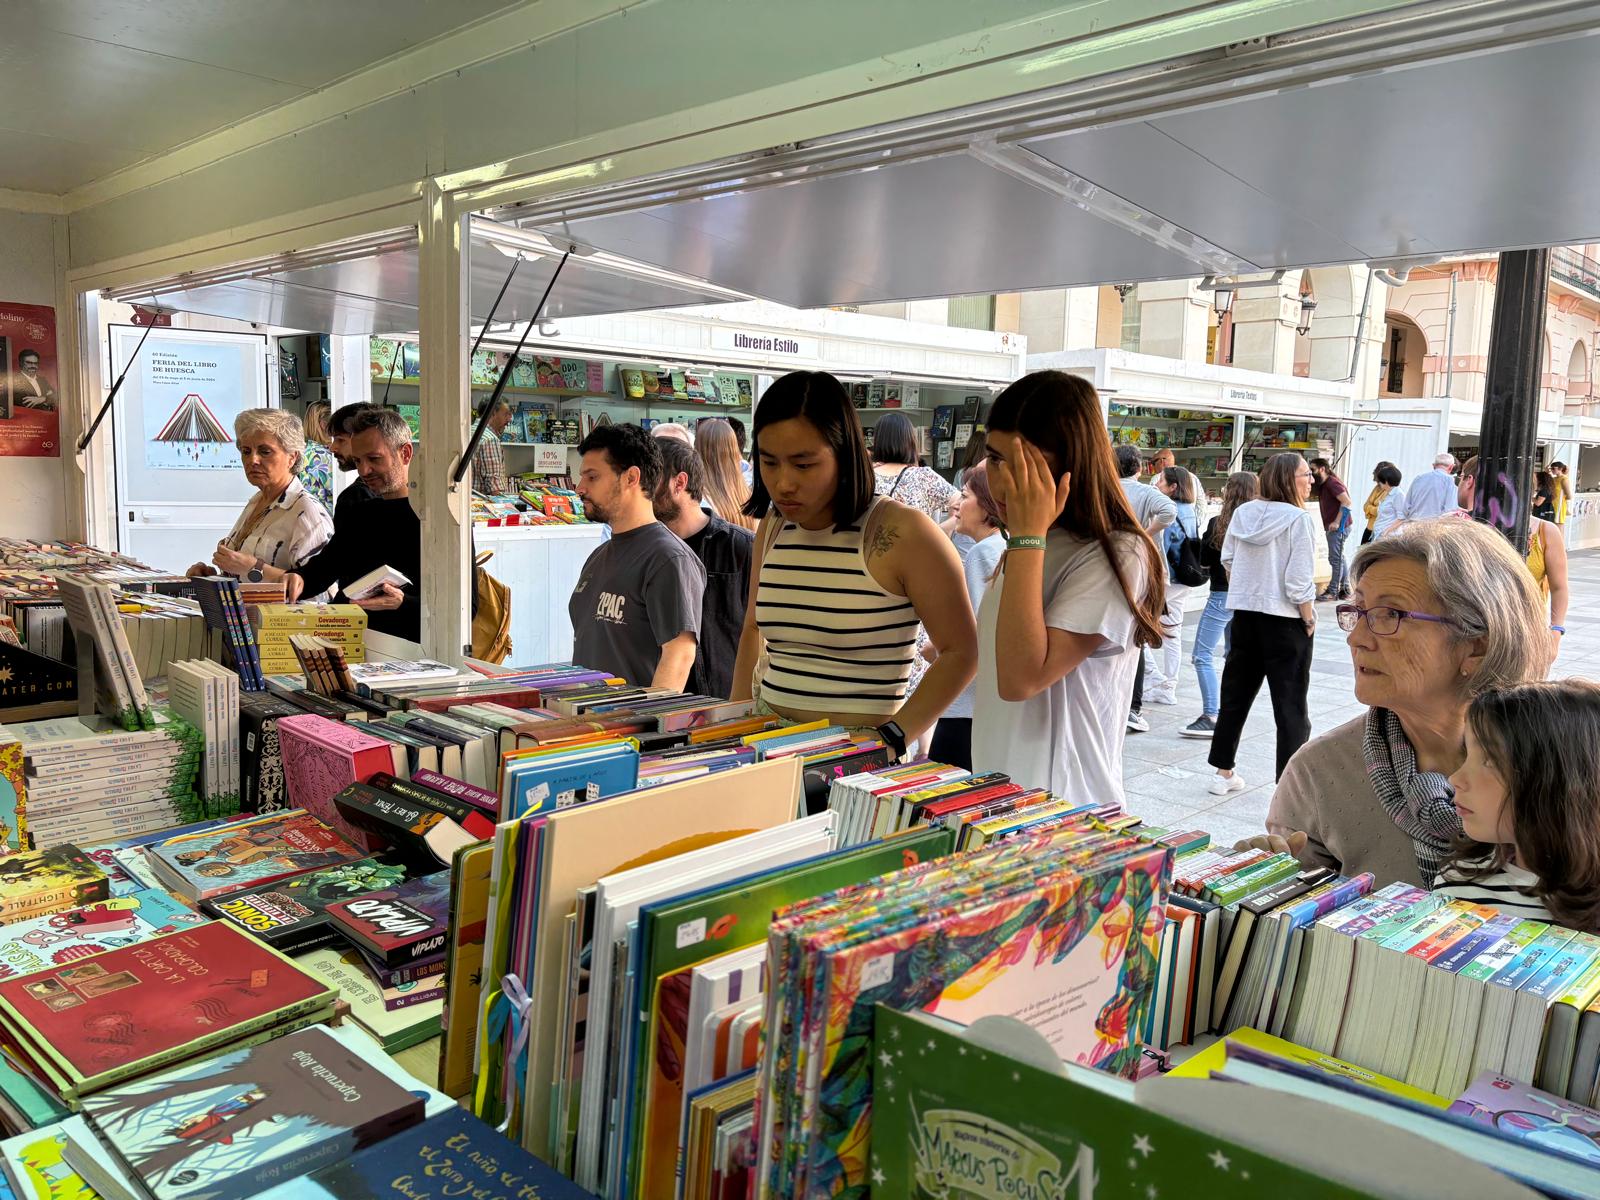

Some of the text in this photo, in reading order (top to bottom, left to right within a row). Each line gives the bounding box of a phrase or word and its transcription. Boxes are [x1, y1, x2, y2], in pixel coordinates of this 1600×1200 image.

[734, 333, 798, 354] Librería Estilo
[543, 451, 558, 460] 10%
[596, 591, 626, 620] 2PAC
[318, 616, 349, 624] Covadonga
[8, 893, 65, 910] LIGHTFALL
[220, 899, 281, 932] SONIC
[168, 972, 186, 984] LA
[416, 966, 428, 977] LOS
[292, 1050, 362, 1103] Caperucita Roja
[255, 1166, 281, 1182] Roja
